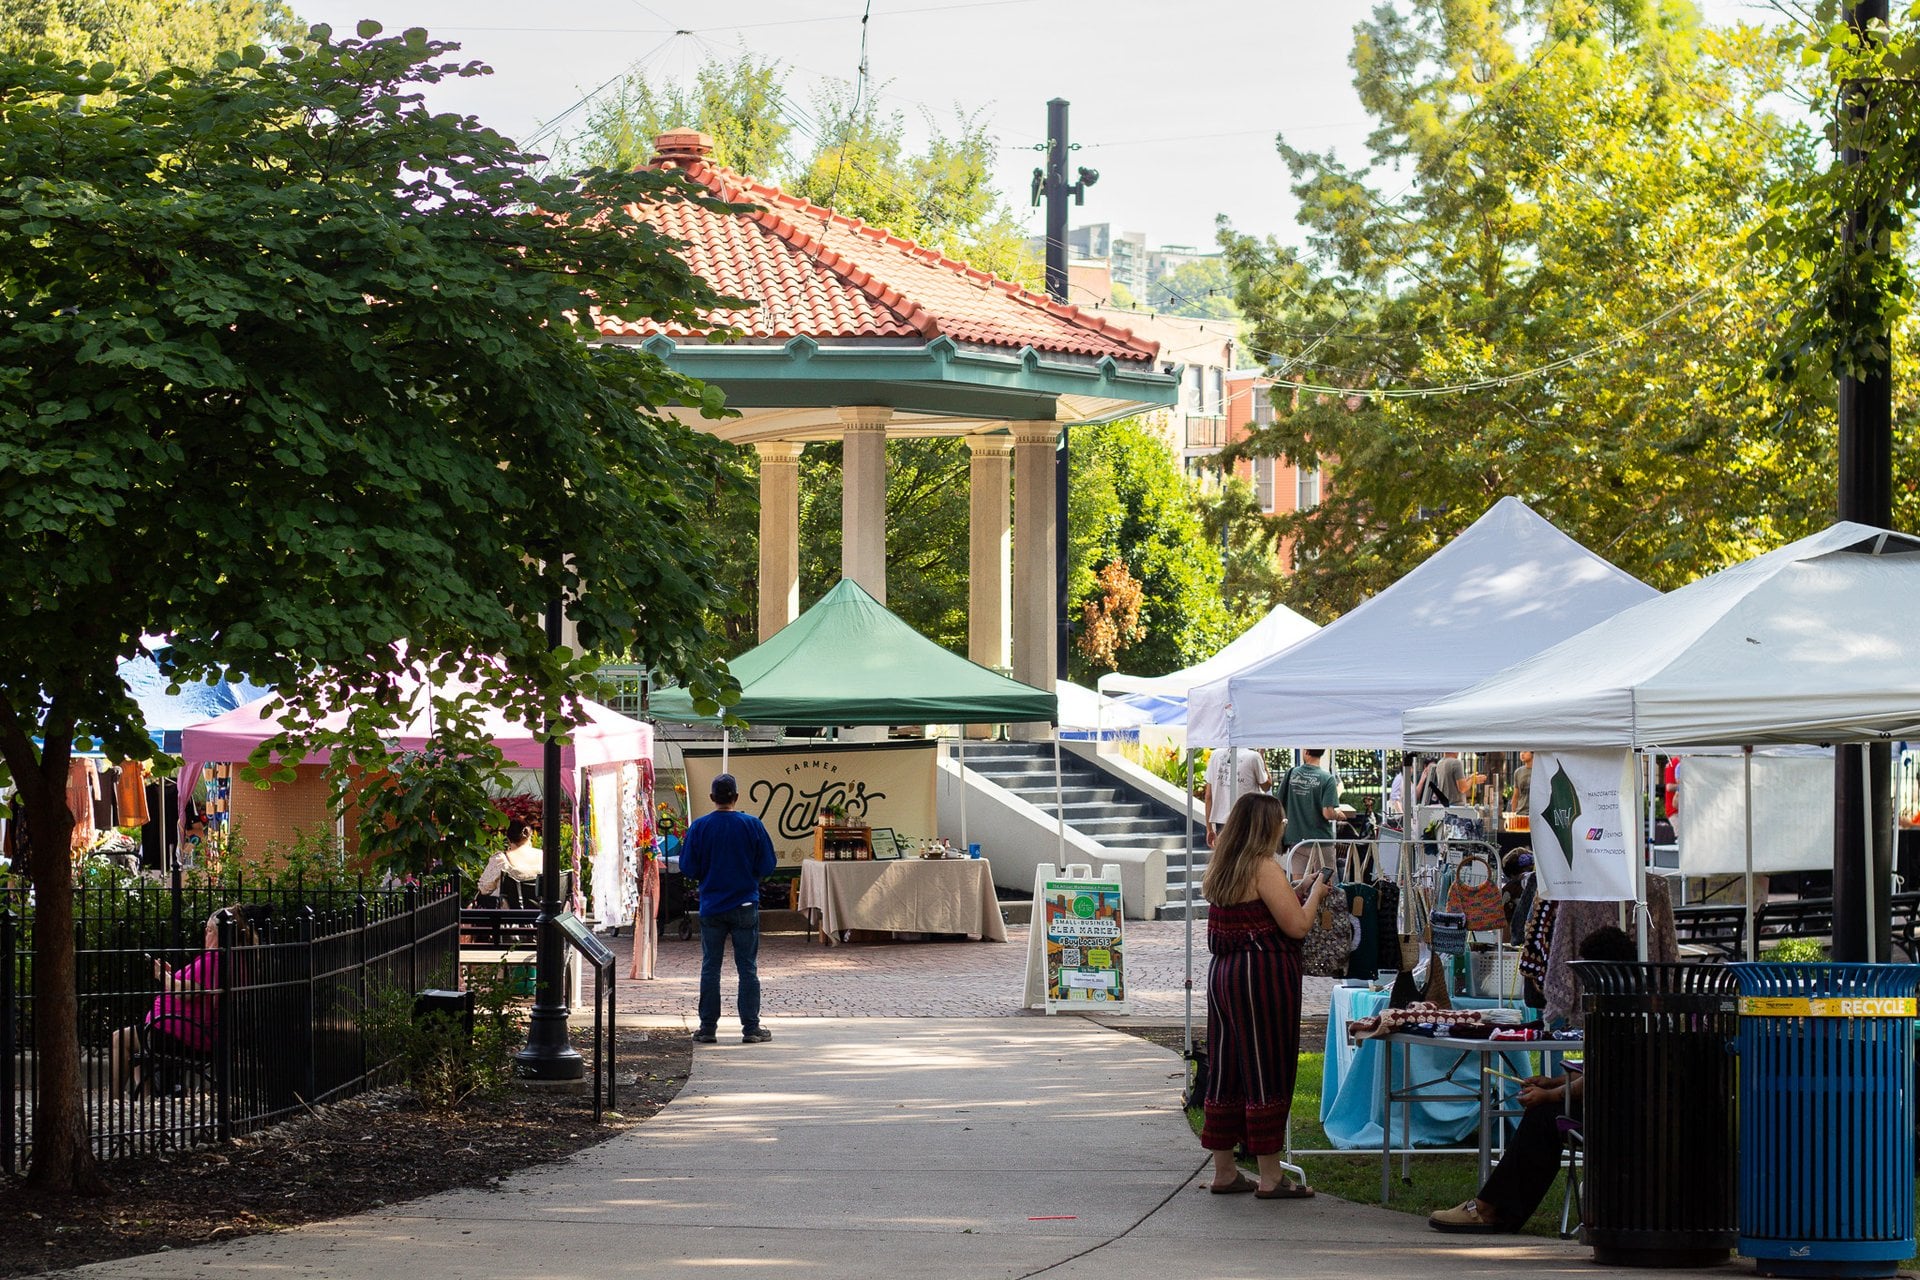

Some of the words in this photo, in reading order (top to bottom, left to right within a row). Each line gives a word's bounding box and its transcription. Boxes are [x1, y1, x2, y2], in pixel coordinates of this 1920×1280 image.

[785, 760, 838, 775] FARMER
[1050, 926, 1076, 934] FLEA
[1079, 927, 1119, 935] MARKET
[1841, 999, 1904, 1014] RECYCLE
